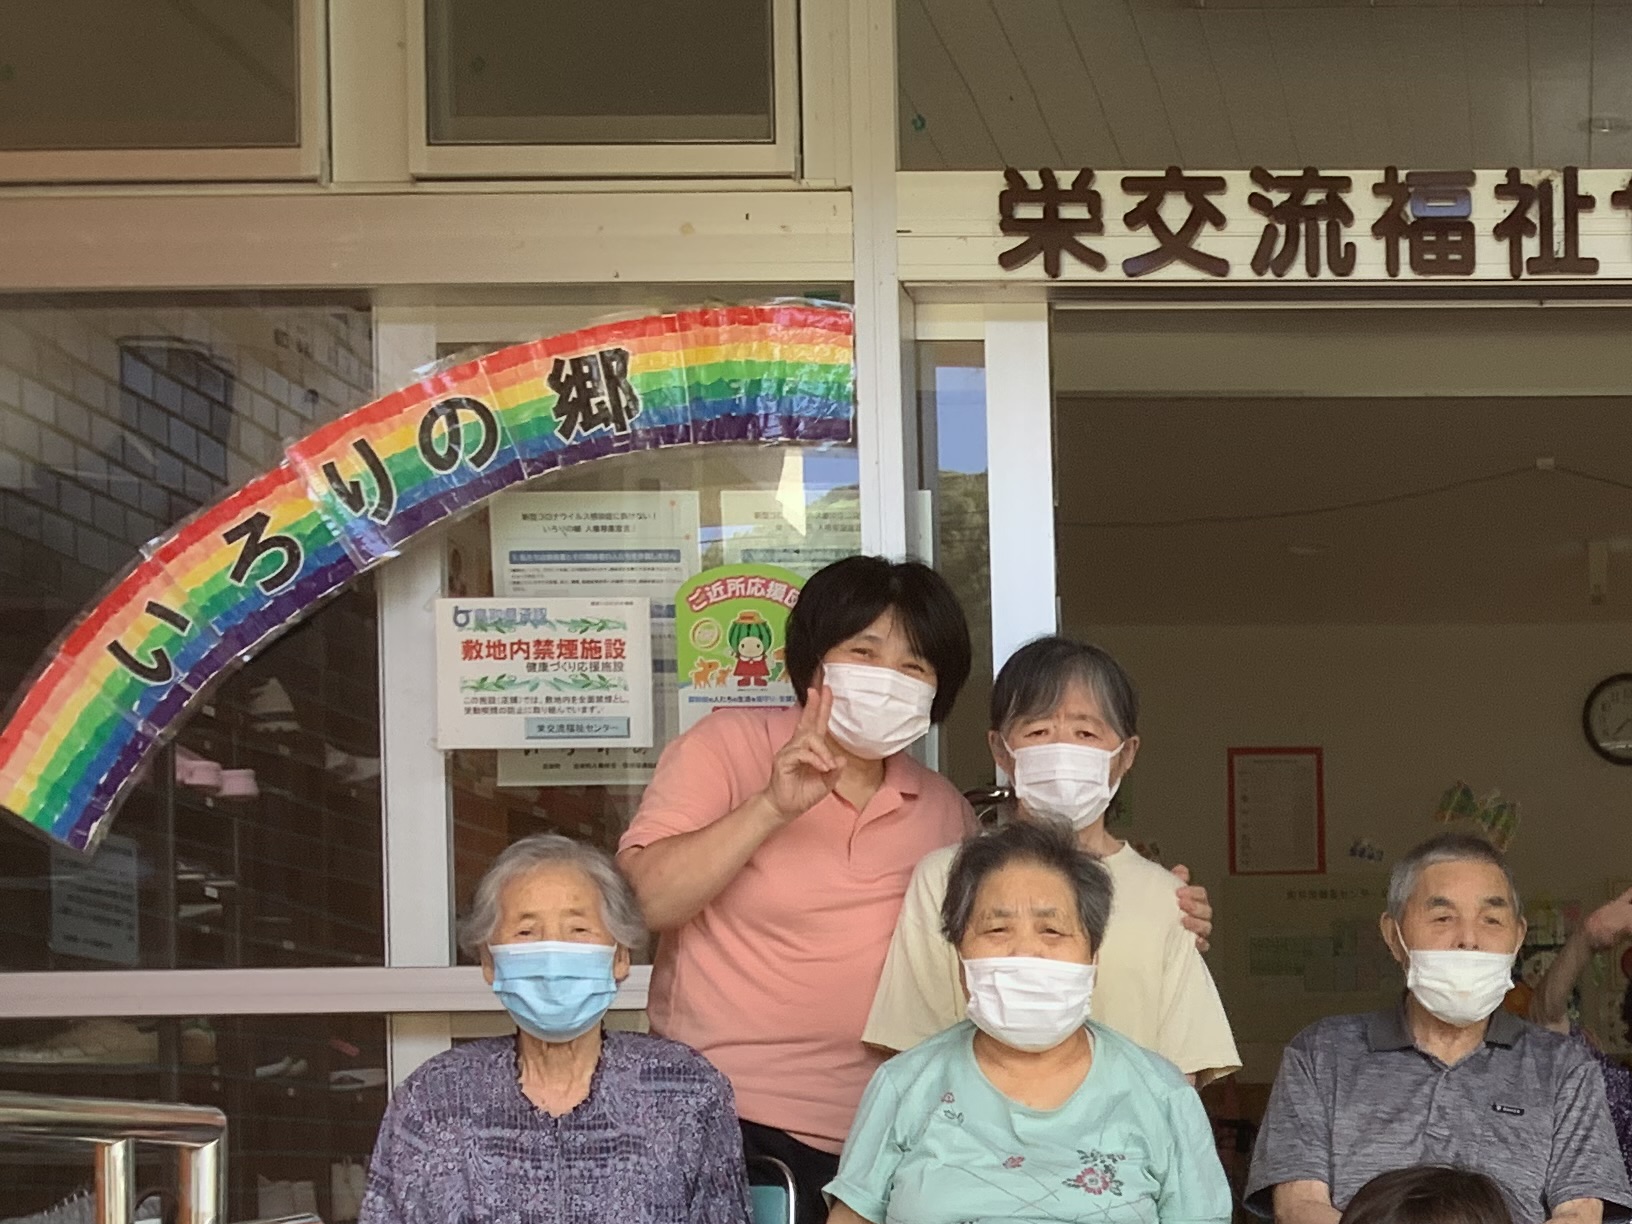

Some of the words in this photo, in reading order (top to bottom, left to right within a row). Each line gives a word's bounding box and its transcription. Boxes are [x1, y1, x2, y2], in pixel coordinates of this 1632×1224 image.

[106, 347, 642, 687] いろりの郷
[461, 638, 626, 661] 敷地内禁煙施設
[526, 662, 625, 673] 健康づくり応援施設
